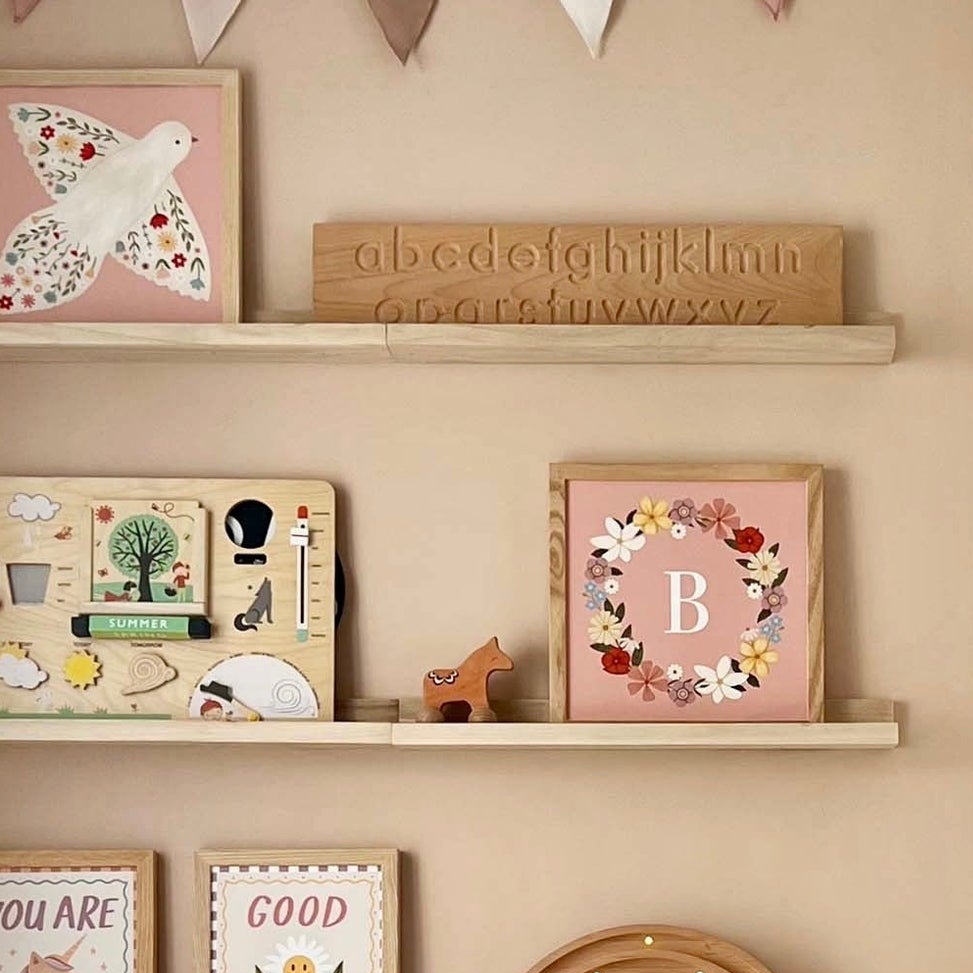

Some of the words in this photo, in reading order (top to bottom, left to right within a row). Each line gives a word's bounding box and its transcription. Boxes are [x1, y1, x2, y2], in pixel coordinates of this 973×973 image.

[663, 570, 710, 634] B
[108, 618, 168, 629] SUMMER
[0, 899, 47, 931] OU
[53, 895, 120, 930] ARE
[247, 895, 348, 928] GOOD
